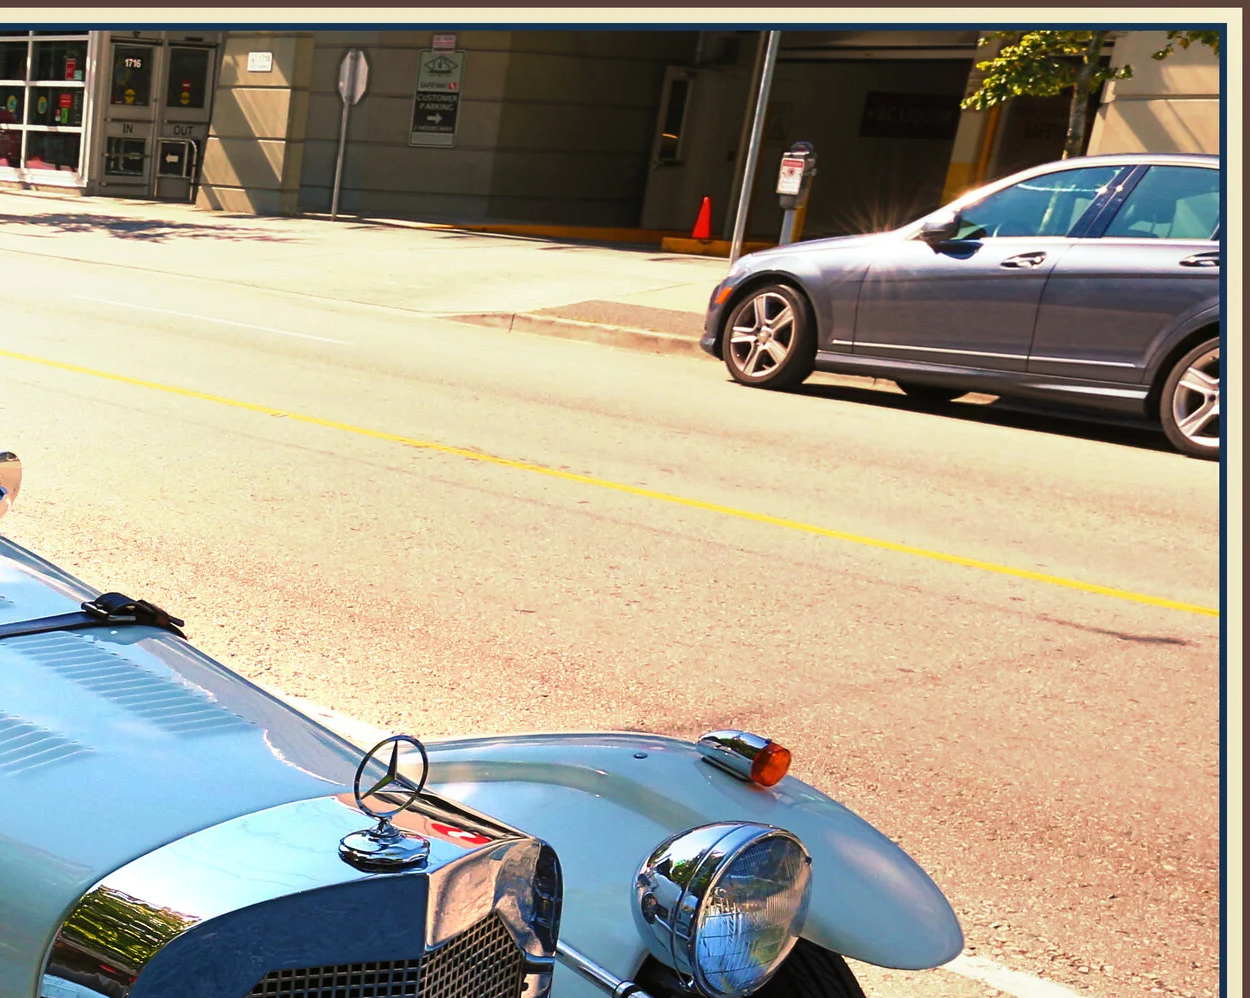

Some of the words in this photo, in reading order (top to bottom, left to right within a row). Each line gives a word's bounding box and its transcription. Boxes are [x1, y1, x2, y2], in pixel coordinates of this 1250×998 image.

[124, 58, 142, 68] 1716
[419, 102, 454, 111] PARKING
[122, 124, 133, 134] IN
[173, 125, 195, 136] OUT
